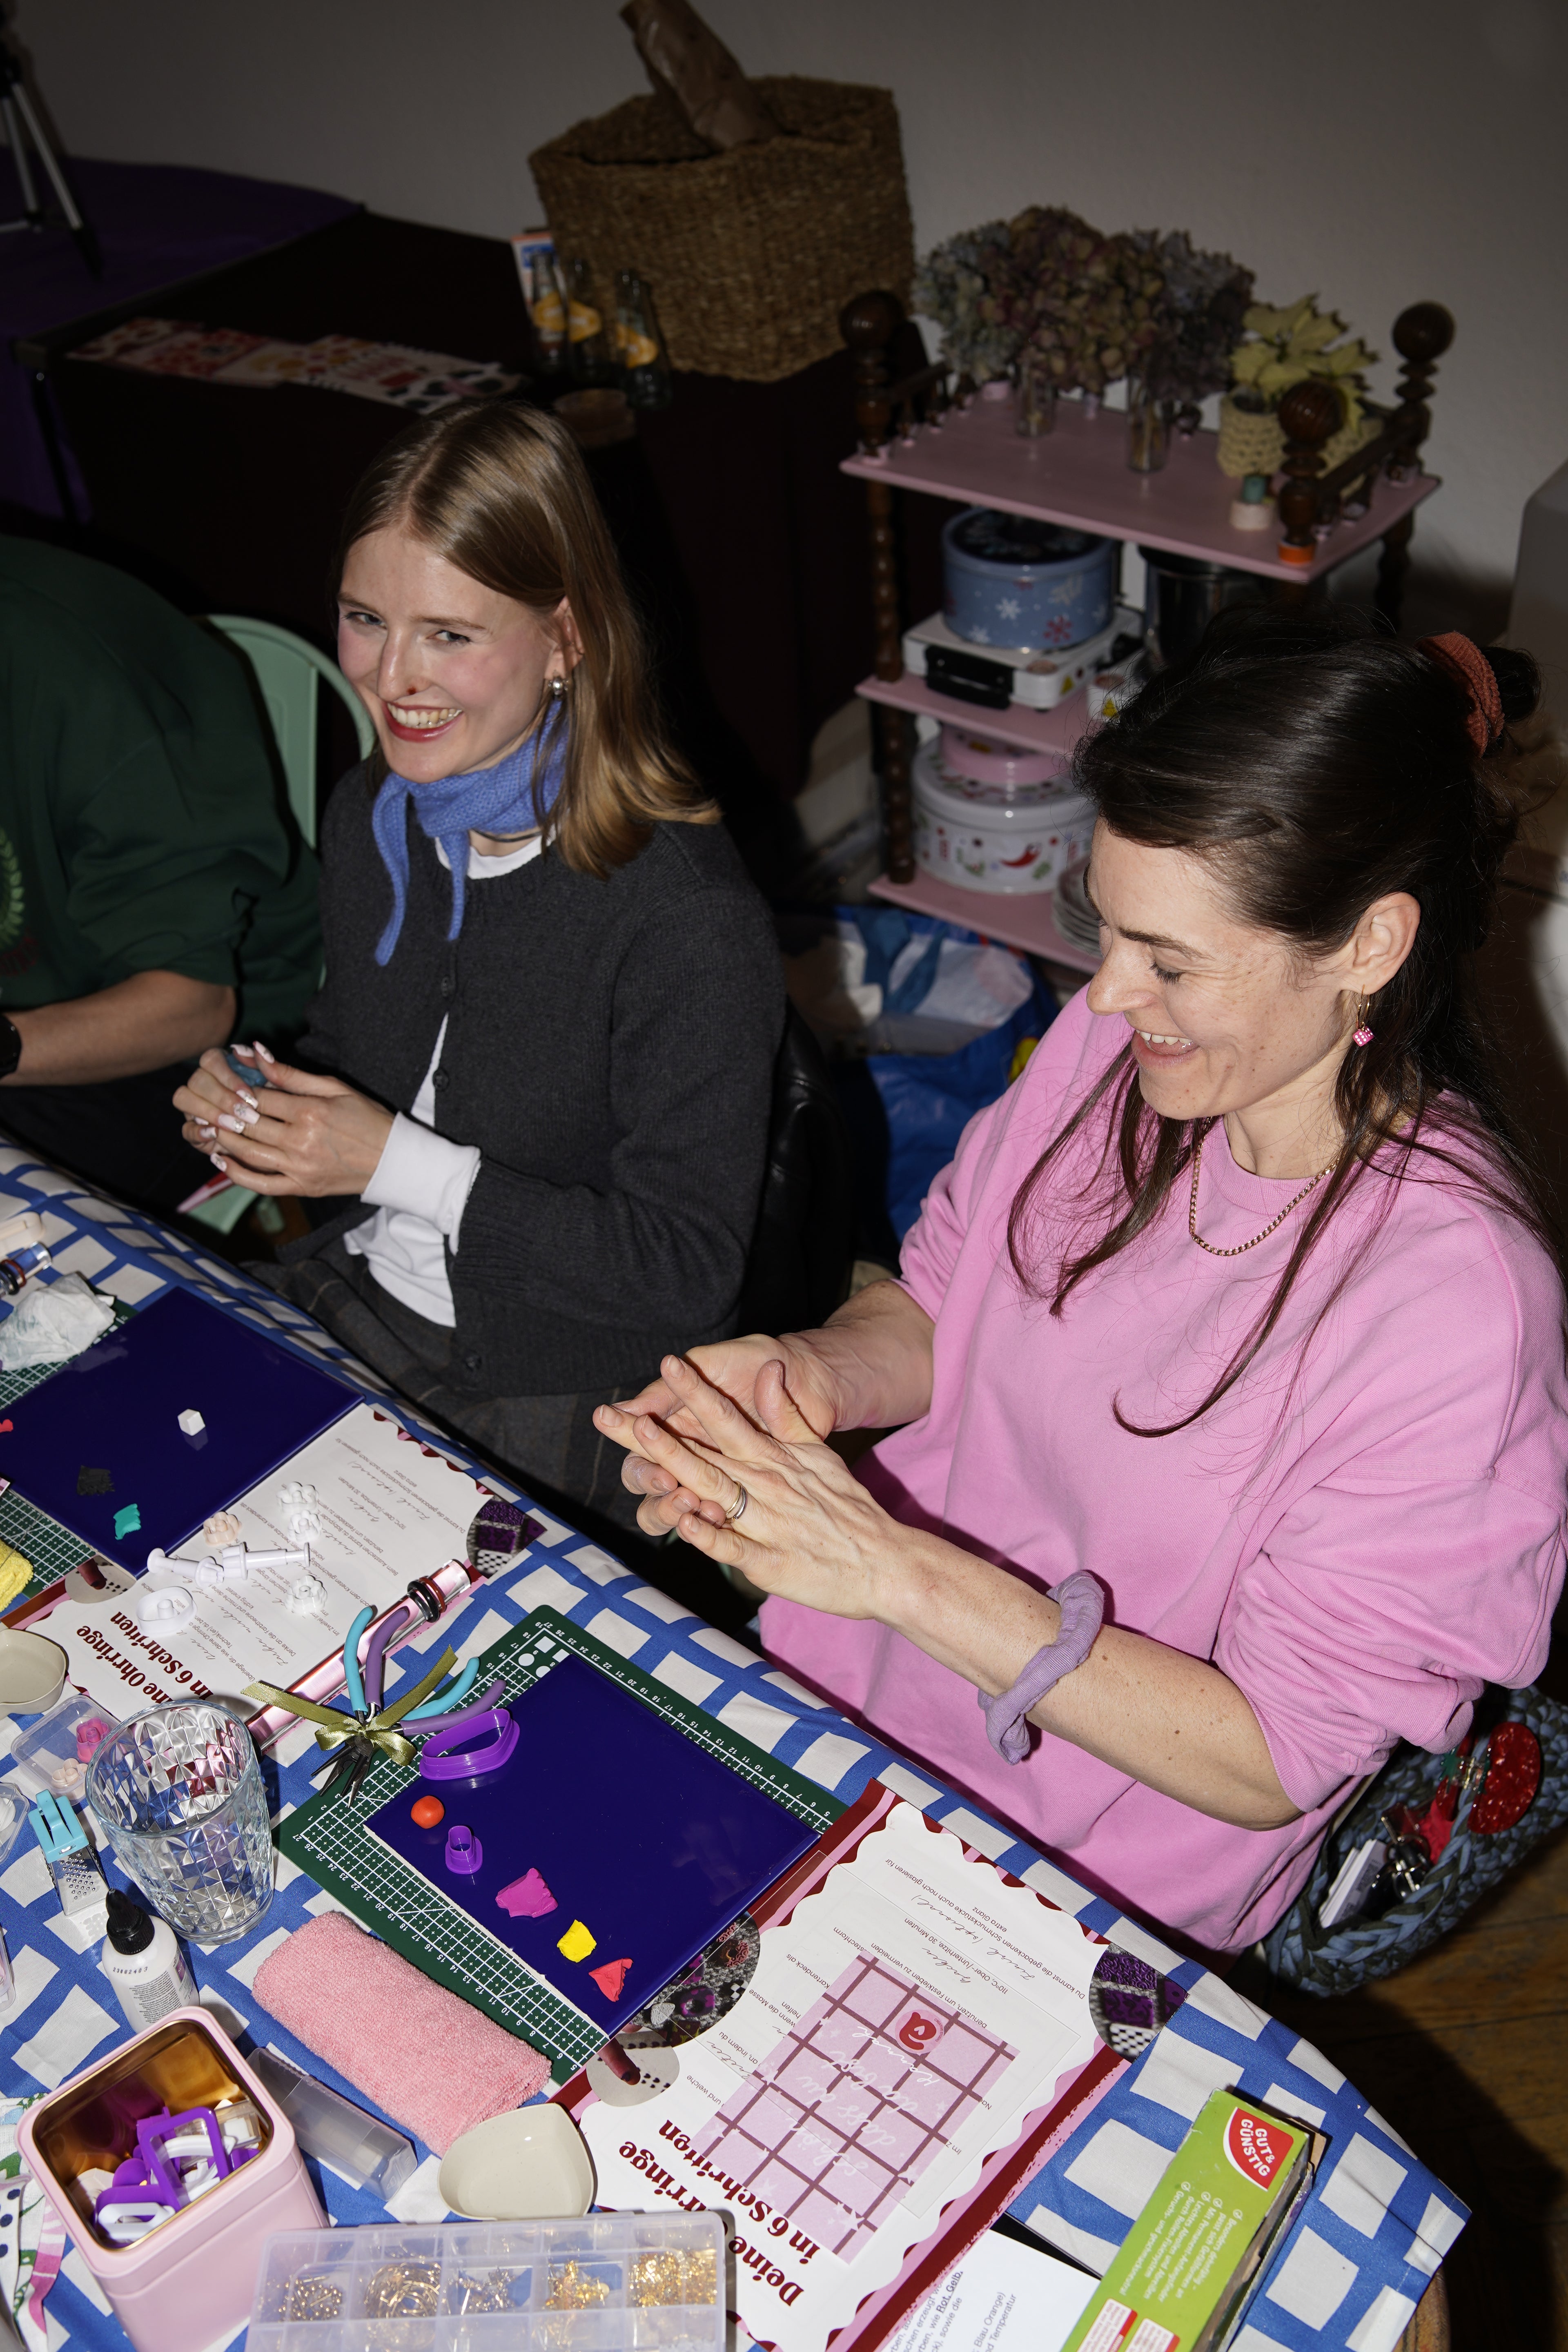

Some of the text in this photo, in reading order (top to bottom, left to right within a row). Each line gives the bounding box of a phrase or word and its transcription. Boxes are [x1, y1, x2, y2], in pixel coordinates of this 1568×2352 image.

[192, 1625, 209, 1639] Ohrringe
[245, 1612, 269, 1633] Farbtheorie
[110, 1611, 183, 1673] Schritten
[207, 1626, 232, 1648] Technik(en)
[209, 1638, 221, 1649] deine
[77, 1626, 145, 1686] Ohrringe
[190, 1638, 215, 1659] Deine
[256, 1637, 288, 1665] Farben
[281, 1644, 296, 1656] Denke
[175, 1670, 192, 1683] 6
[235, 1663, 255, 1681] Überlege
[895, 1864, 923, 1884] glasieren
[351, 1882, 360, 1890] 22
[922, 1883, 938, 1895] noch
[938, 1894, 954, 1907] auch
[904, 1918, 929, 1937] Minuten
[954, 1906, 1002, 1941] Schmuckstücke
[972, 1907, 1007, 1931] extra Glanz
[424, 1943, 433, 1951] 16
[833, 1927, 864, 1951] stechform
[911, 1895, 1035, 1980] Finish (optional)
[437, 1954, 445, 1962] 15
[871, 1943, 902, 1968] vermeiden
[939, 1941, 990, 1980] Ober-/Unterhitze,
[1002, 1939, 1042, 1968] gebackenen
[450, 1964, 459, 1973] 14
[795, 1961, 830, 1989] Kartendeck
[922, 1948, 971, 1982] Backen
[1042, 1967, 1052, 1975] die
[463, 1975, 471, 1983] 13
[475, 1985, 484, 1994] 12
[911, 1972, 944, 1998] Festkleben
[1052, 1974, 1075, 1992] kannst
[944, 1996, 956, 2005] um
[1075, 1990, 1085, 1999] Du
[501, 2007, 510, 2015] 10
[749, 1989, 795, 2027] wenn die Masse
[782, 2001, 801, 2019] helfen
[728, 2039, 748, 2057] indem
[852, 2026, 939, 2085] Hannah
[749, 2054, 757, 2064] an,
[687, 2075, 721, 2104] und welche
[821, 2051, 917, 2113] da bist
[800, 2076, 895, 2146] dass du
[952, 2145, 961, 2154] Im
[1240, 2118, 1271, 2176] GÜNSTIG
[1254, 2128, 1275, 2164] GUT&
[659, 2120, 819, 2263] in 6 Schritten
[619, 2142, 803, 2305] Deine rringe
[917, 2295, 935, 2327] erzeugt
[930, 2314, 940, 2328] wie
[940, 2298, 962, 2337] sowie die
[974, 2292, 1006, 2347] Blau Orange)
[989, 2294, 1016, 2340] Temperatur
